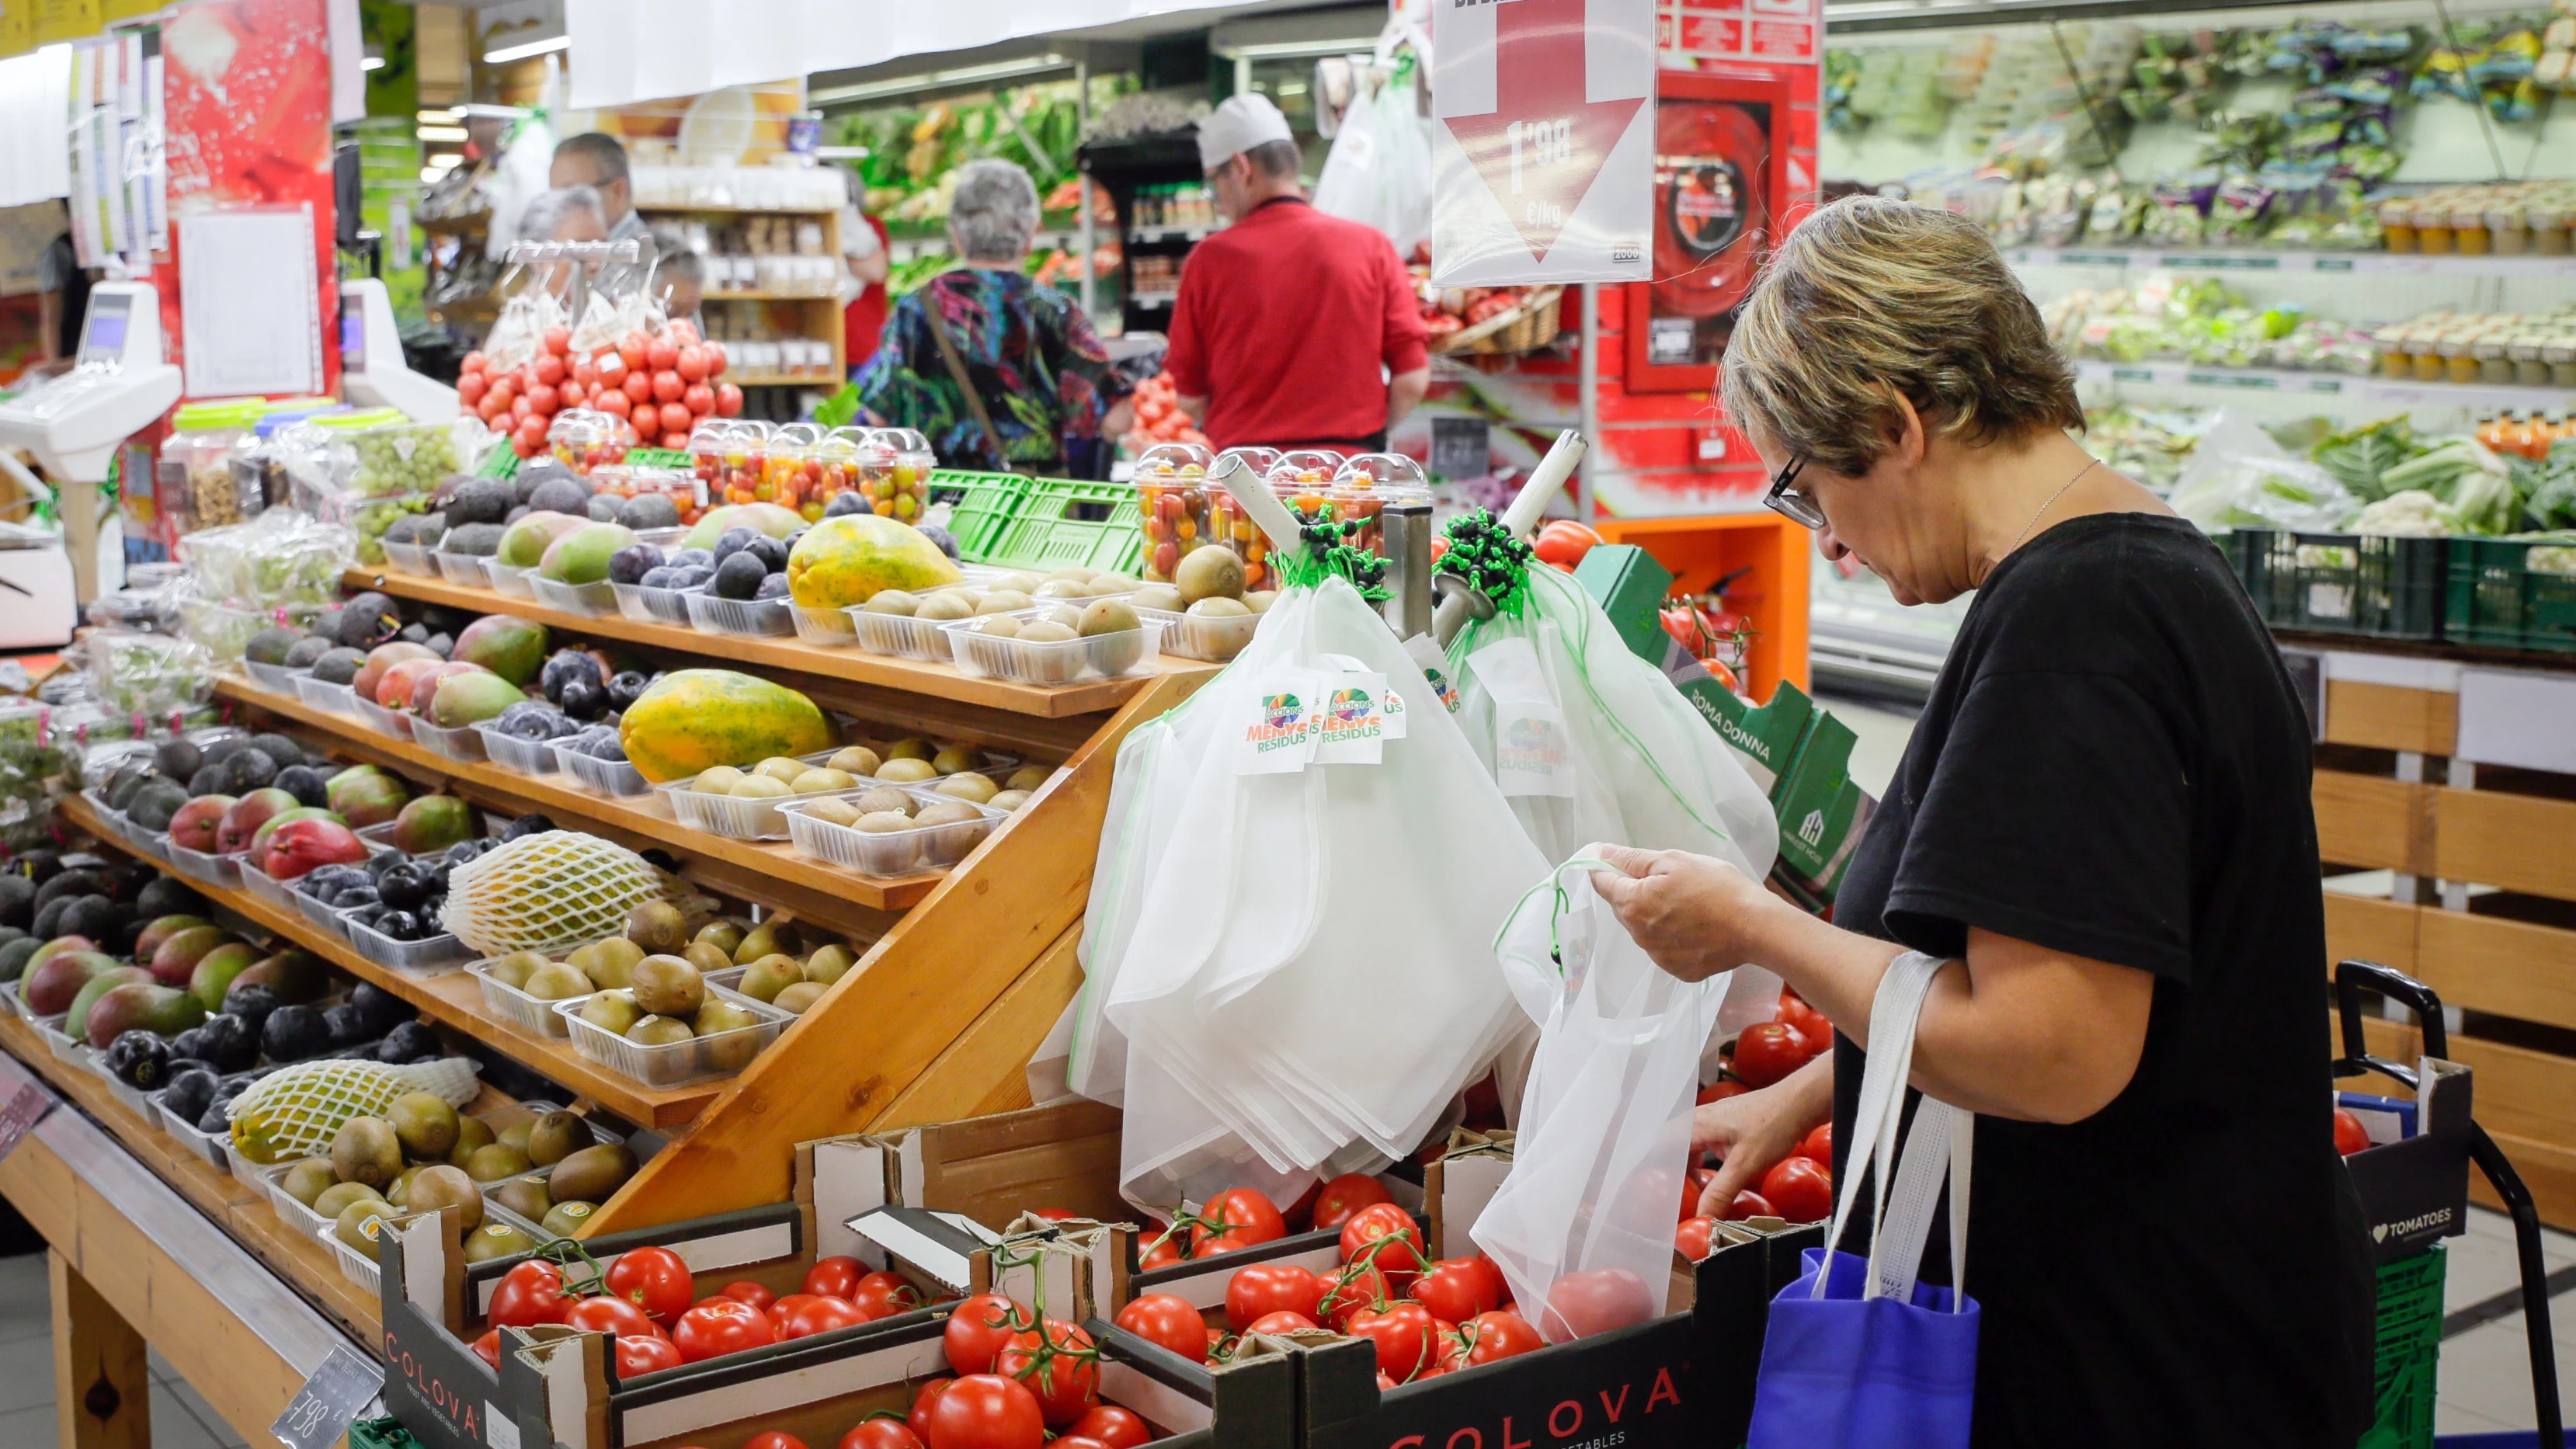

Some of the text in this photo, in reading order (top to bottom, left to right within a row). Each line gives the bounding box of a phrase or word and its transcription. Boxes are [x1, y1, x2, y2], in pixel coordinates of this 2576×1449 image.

[1525, 200, 1562, 229] €/kg
[1615, 248, 1639, 259] 2000
[1266, 706, 1305, 718] ACCIONS
[1330, 700, 1375, 711] ACCIONS
[1692, 688, 1722, 727] ROMA
[1246, 722, 1308, 742] MENYS
[1257, 731, 1306, 753] RESIDUS
[1322, 725, 1382, 744] RESIDUS
[1723, 719, 1770, 760] DONNA
[2390, 1208, 2452, 1237] TOMATOES
[386, 1332, 478, 1441] COLOVA
[431, 1404, 461, 1438] VEGETABLES
